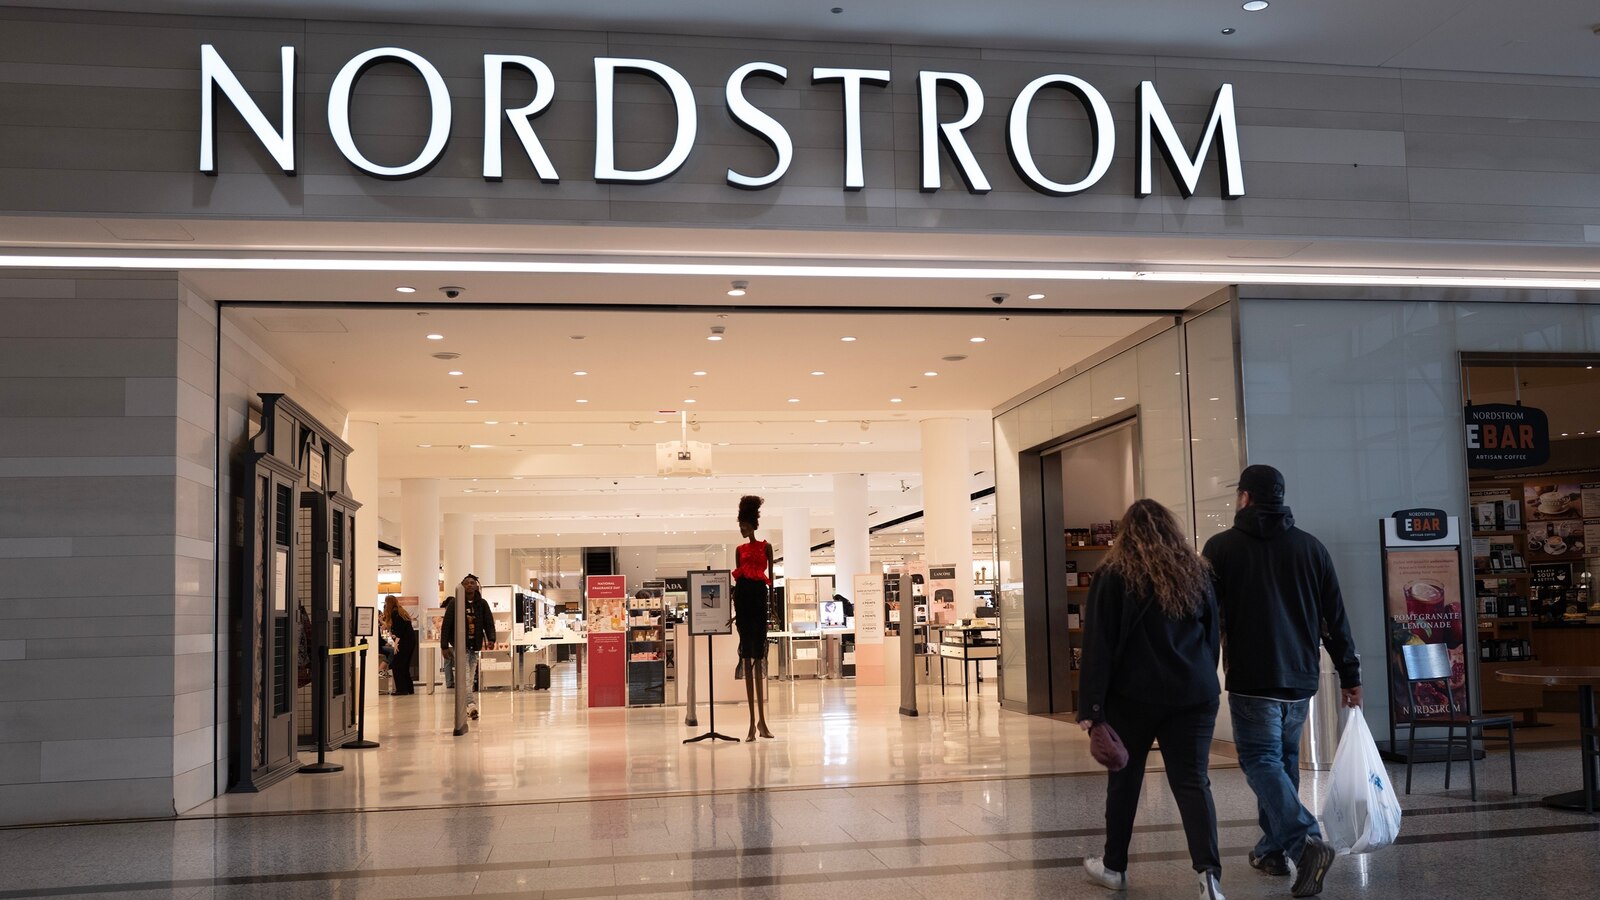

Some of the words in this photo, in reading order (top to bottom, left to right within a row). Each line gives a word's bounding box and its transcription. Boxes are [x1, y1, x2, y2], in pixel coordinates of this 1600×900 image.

[200, 43, 1246, 199] NORDSTROM
[1472, 411, 1524, 420] NORDSTROM
[1466, 424, 1535, 449] EBAR
[1405, 518, 1441, 532] EBAR
[1393, 612, 1460, 622] POMEGRANATE
[1402, 621, 1452, 630] LEMONADE
